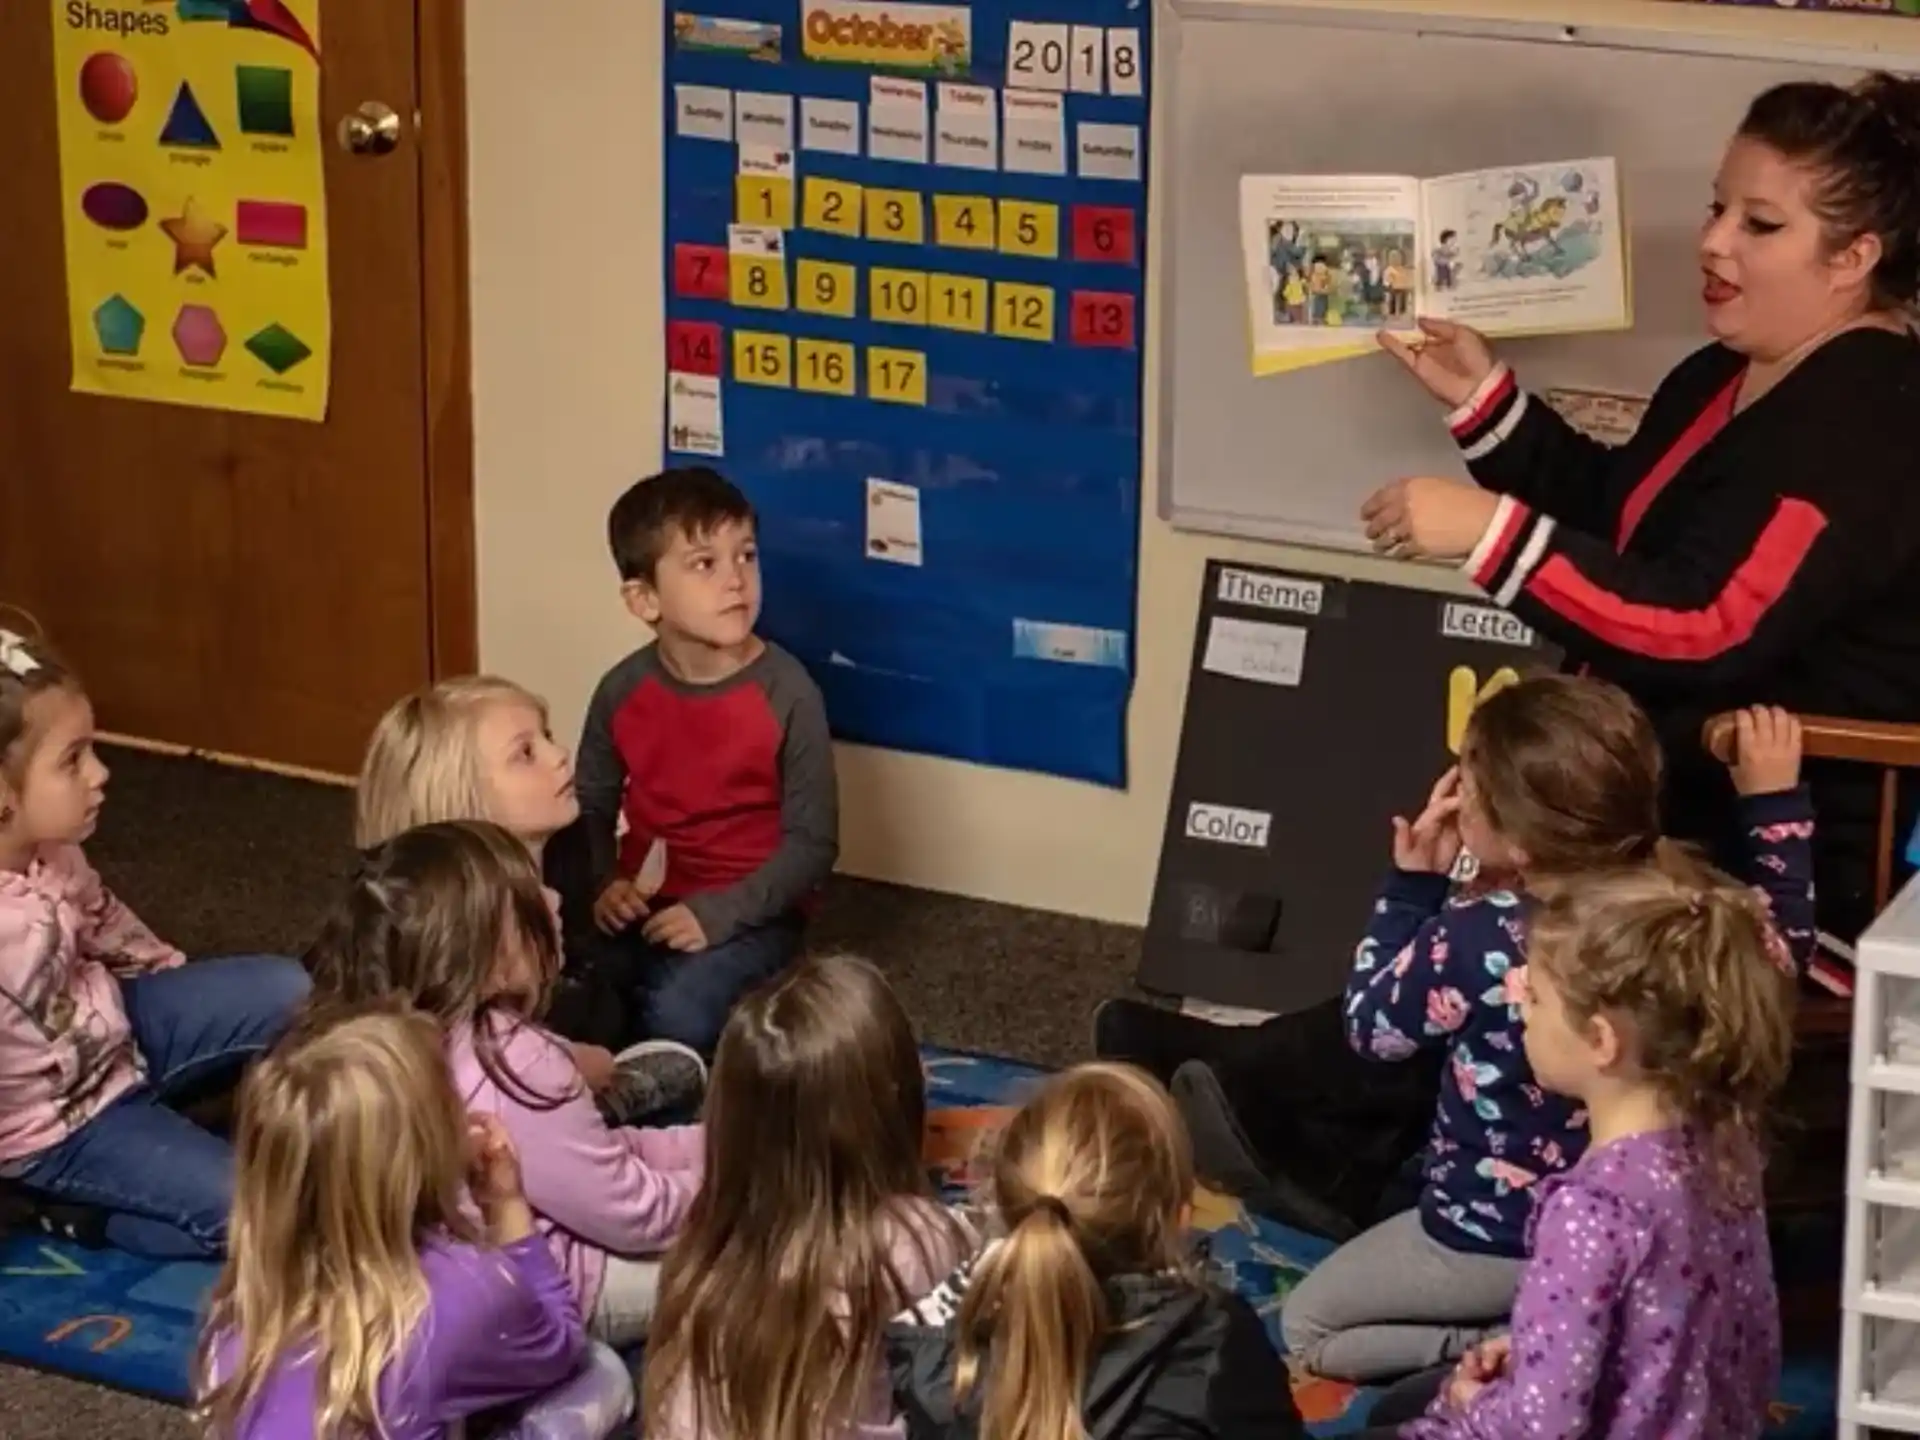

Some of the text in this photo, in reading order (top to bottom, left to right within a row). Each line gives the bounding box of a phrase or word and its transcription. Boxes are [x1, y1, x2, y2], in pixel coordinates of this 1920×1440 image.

[66, 0, 169, 38] Shapes
[806, 9, 933, 50] October
[1013, 40, 1135, 78] 2018
[760, 187, 1114, 252] 1 2 3 4 5 6
[691, 256, 1123, 336] 7 8 9 10 11 12 13
[679, 334, 916, 391] 14 15 16 17
[1223, 572, 1320, 612] Theme
[1446, 604, 1529, 640] Letter
[1190, 808, 1265, 842] Color
